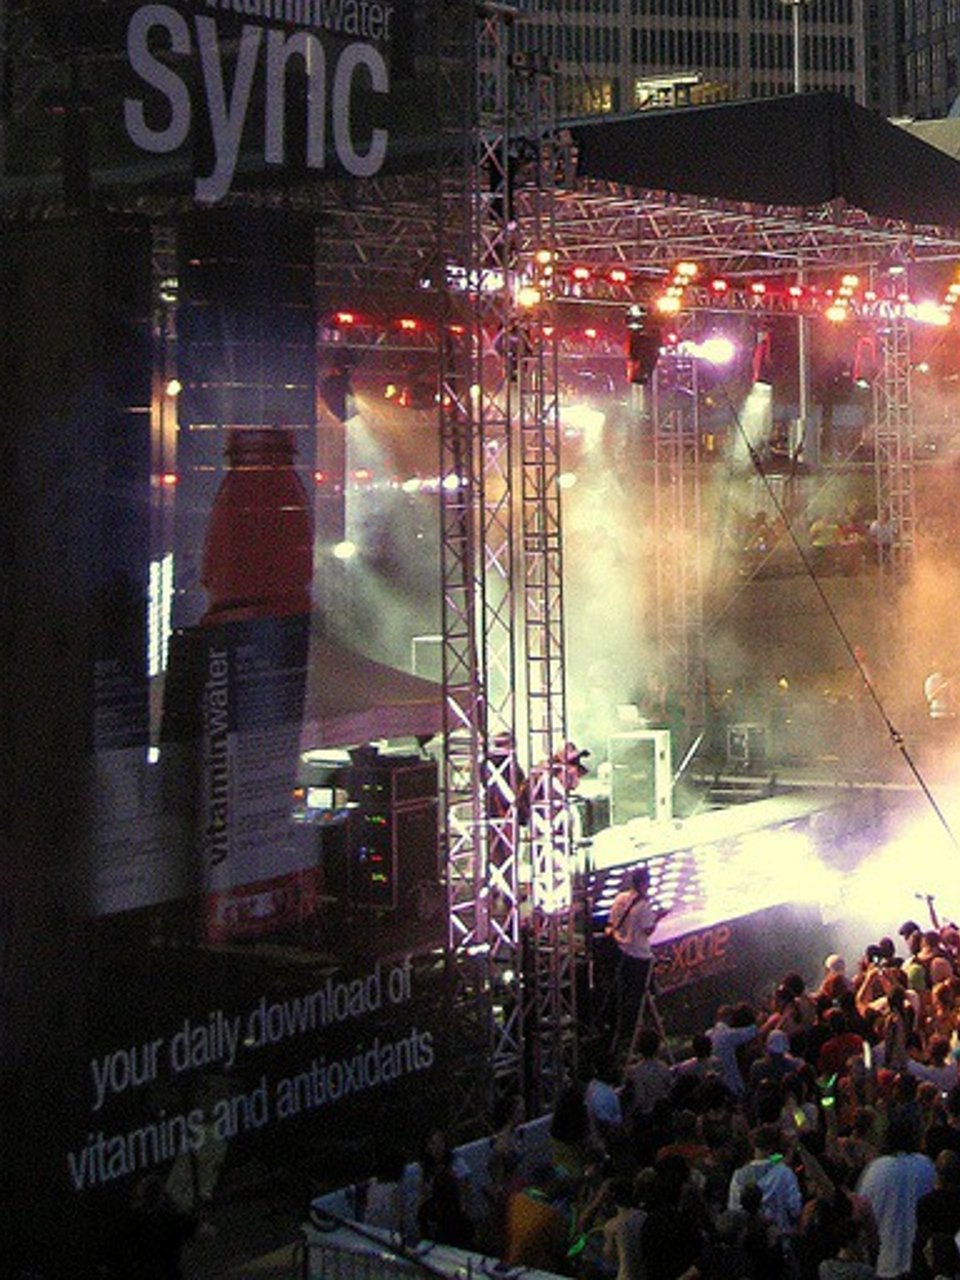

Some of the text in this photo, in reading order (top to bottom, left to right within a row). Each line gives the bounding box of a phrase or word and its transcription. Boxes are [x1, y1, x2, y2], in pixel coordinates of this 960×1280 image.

[66, 1026, 435, 1192] vitamins and antioxidants
[90, 954, 414, 1111] your daily download of
